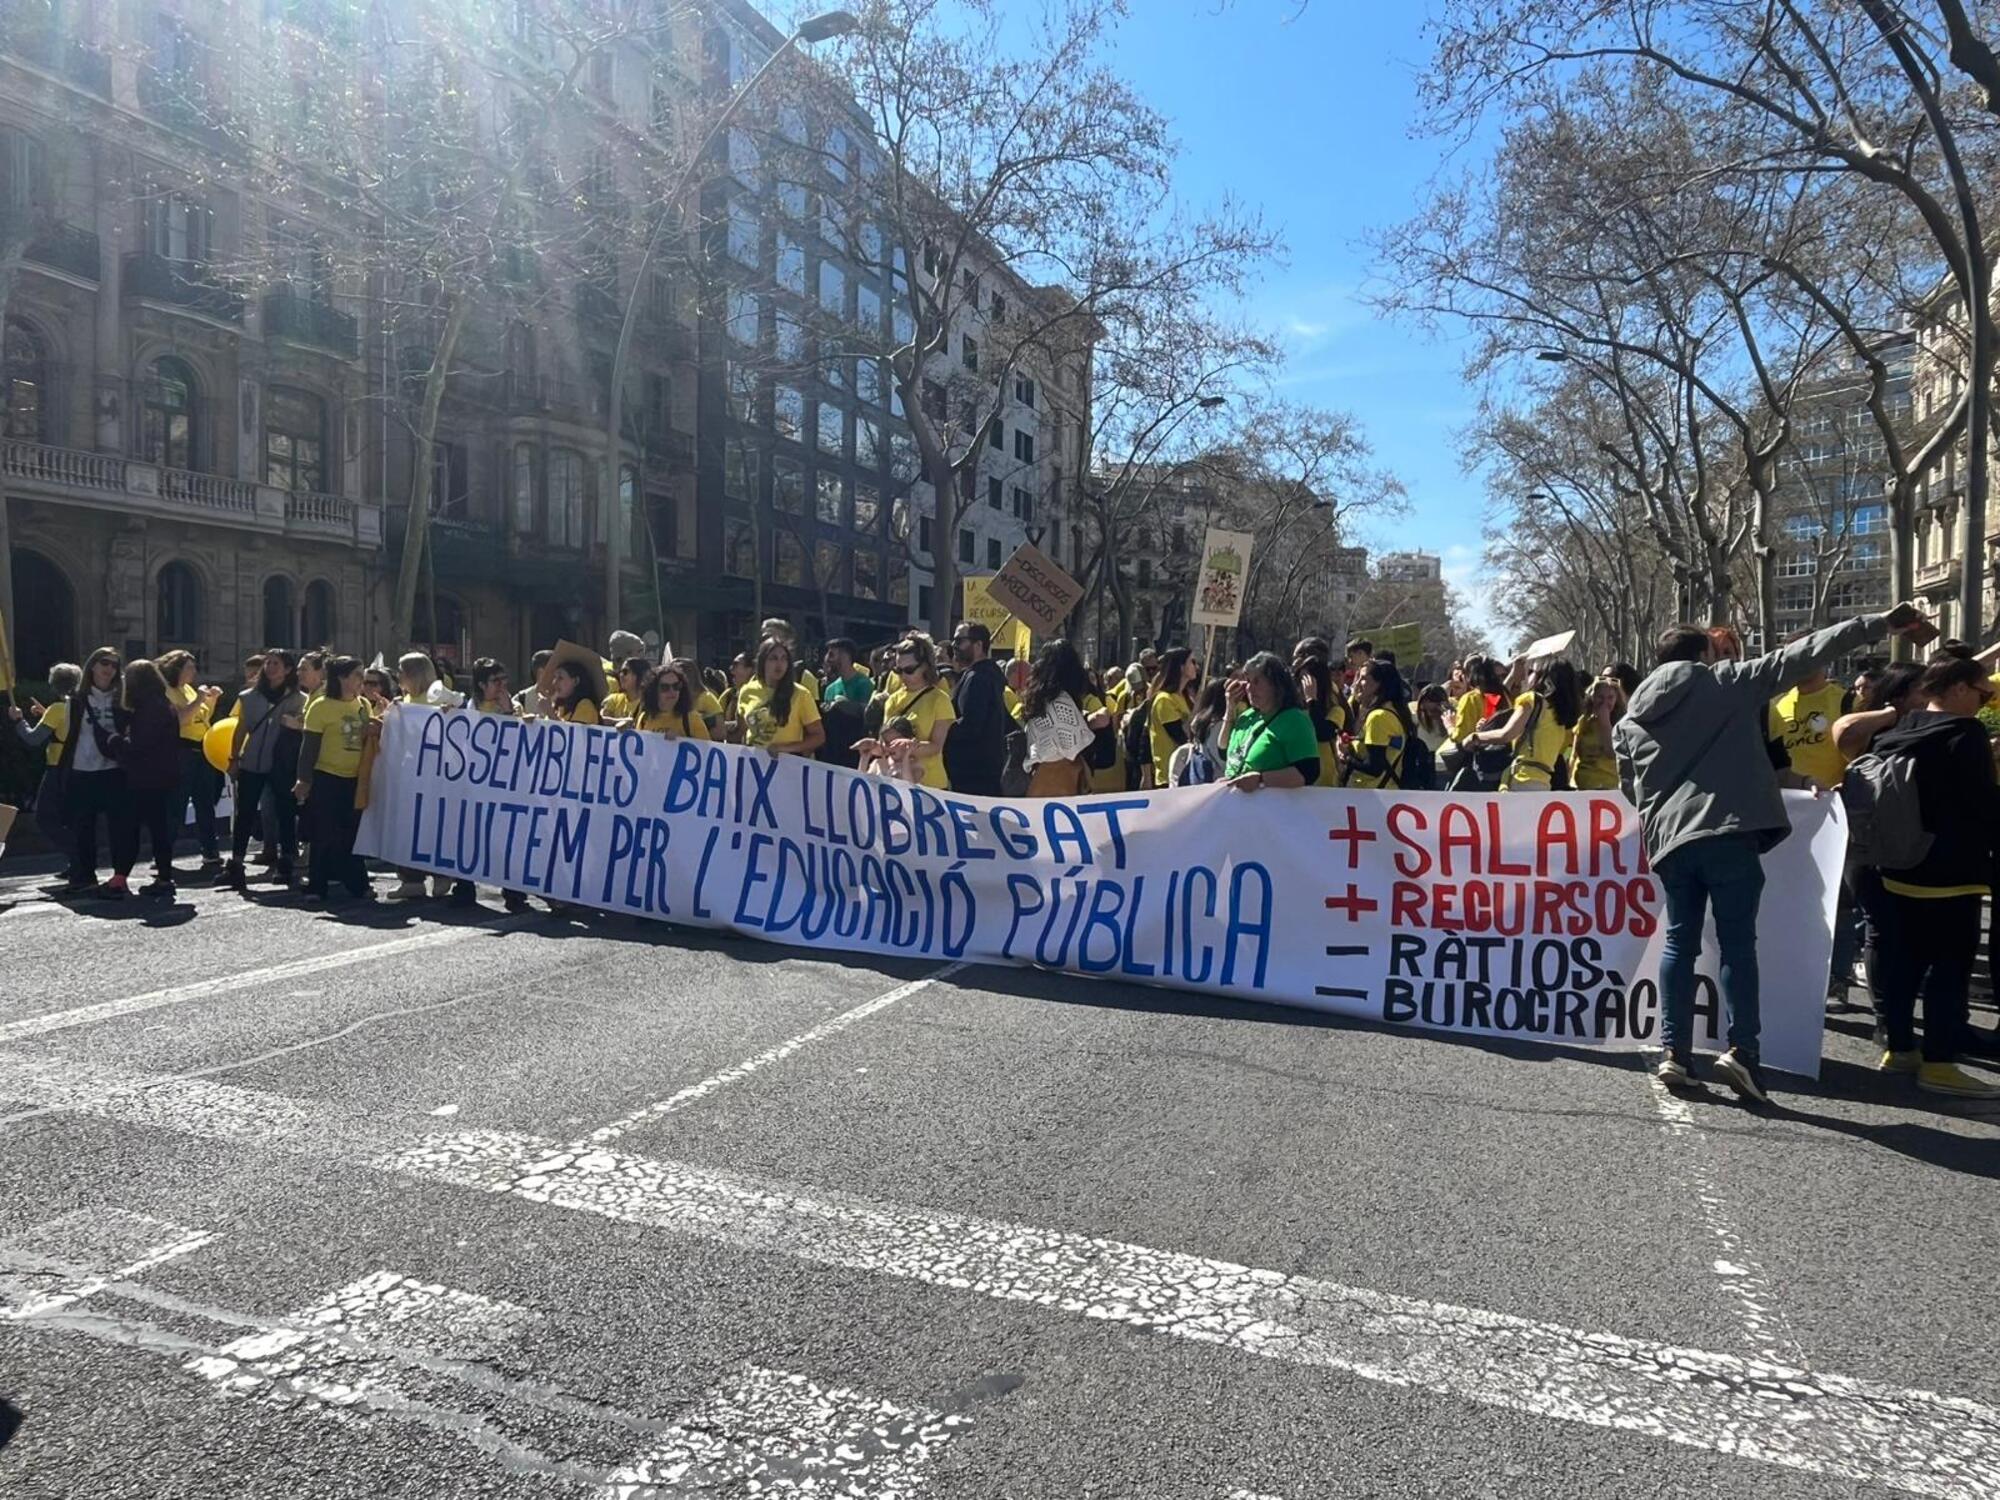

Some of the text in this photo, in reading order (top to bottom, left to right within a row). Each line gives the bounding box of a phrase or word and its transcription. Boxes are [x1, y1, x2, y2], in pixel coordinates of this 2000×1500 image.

[417, 712, 1150, 870] ASSEMBLEES BAIX LLOBREGAT
[411, 793, 1274, 989] LLUITEM PER L'EDUCACIÓ PÚBLICA
[1391, 879, 1658, 938] RECURSOS
[1390, 929, 1606, 993] RÀTIOS
[1383, 970, 1719, 1040] BUROCRÀCA
